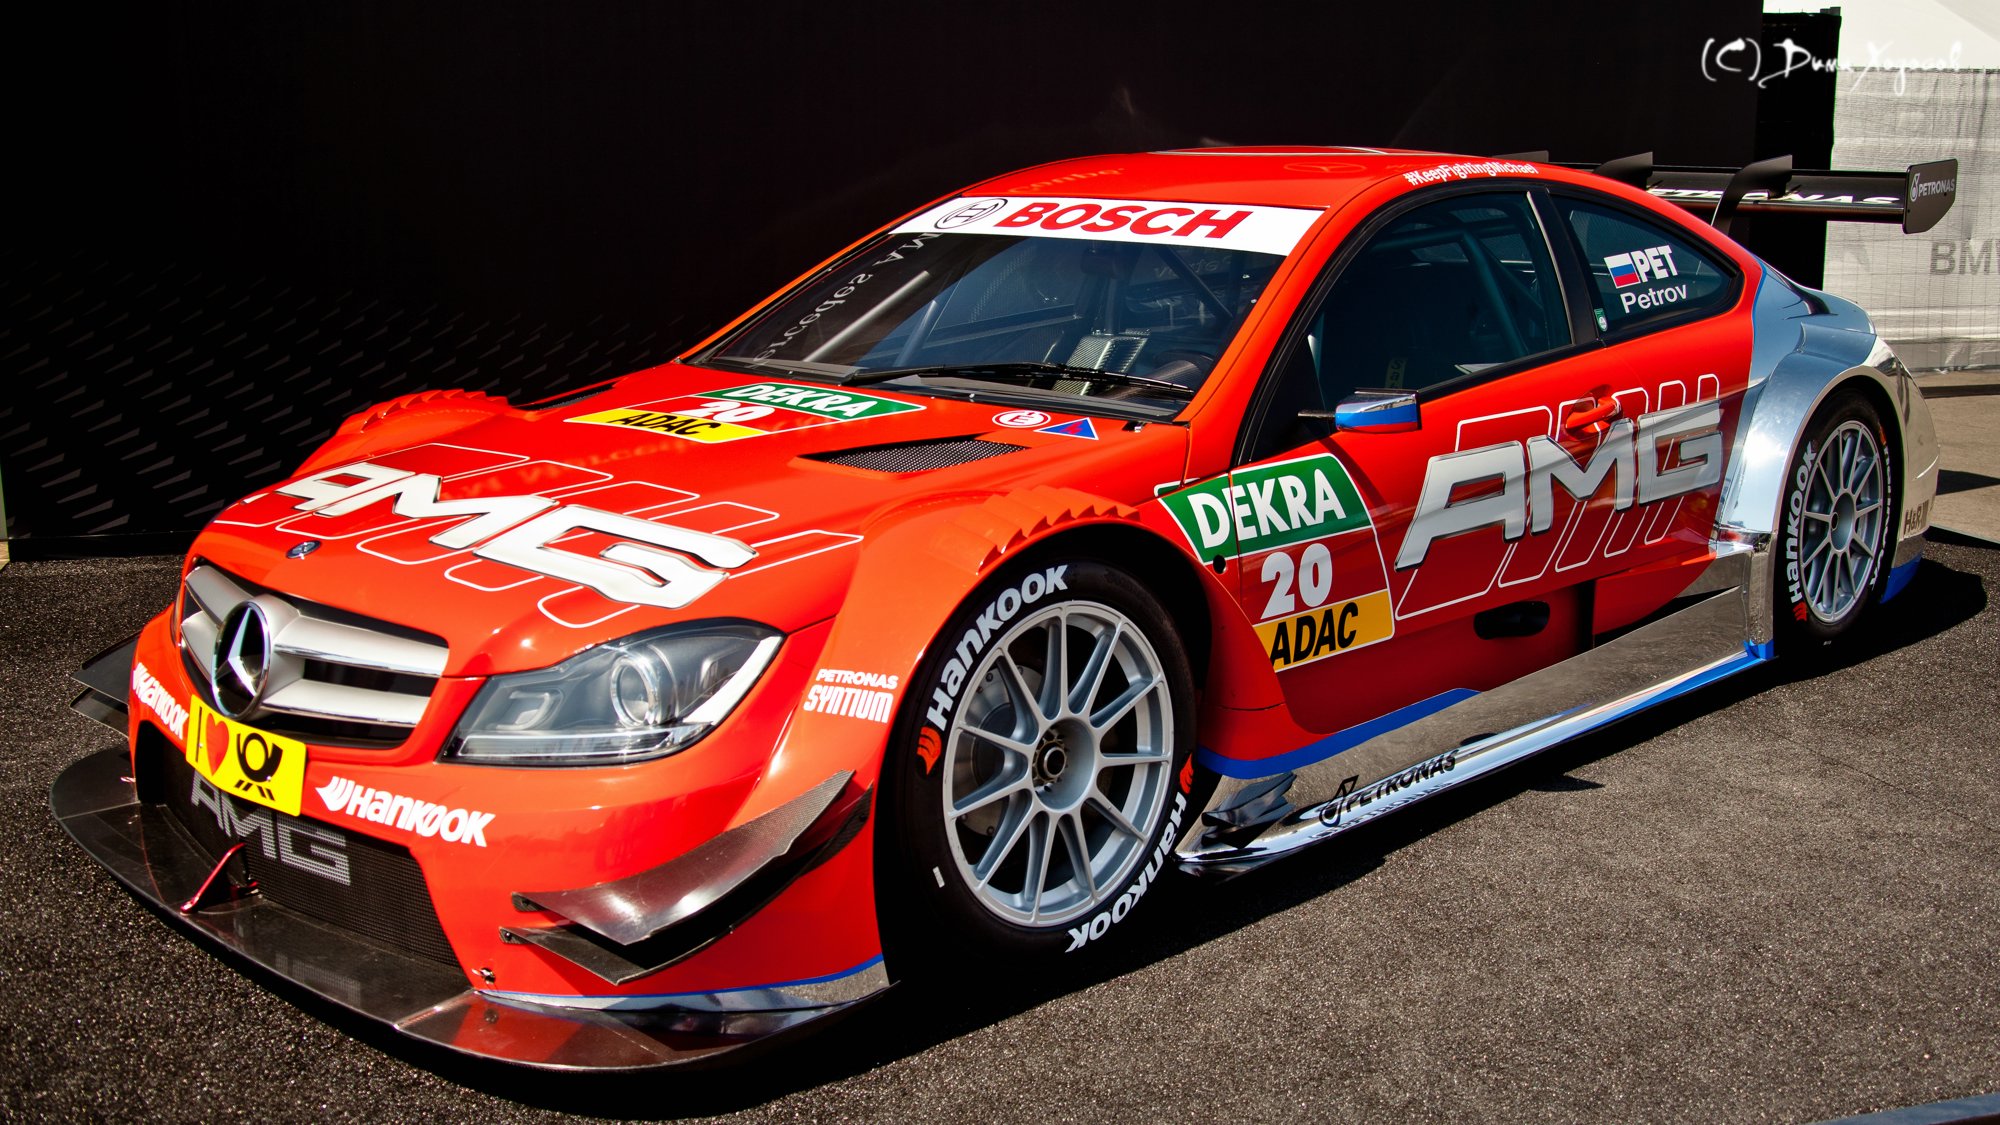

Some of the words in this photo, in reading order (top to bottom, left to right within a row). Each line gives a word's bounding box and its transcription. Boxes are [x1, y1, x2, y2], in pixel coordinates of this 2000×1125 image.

[1402, 161, 1540, 187] #KeepFightingMichael
[1917, 177, 1956, 199] PETRONAS
[993, 202, 1253, 240] BOSCH
[1630, 244, 1679, 283] PET
[1620, 284, 1688, 314] Petrov
[668, 400, 775, 423] 20
[721, 384, 879, 418] DEKRA
[607, 412, 722, 436] ADAC
[1395, 400, 1724, 572] AMG
[1186, 468, 1347, 550] DEKRA
[243, 460, 759, 609] AMG
[1260, 543, 1334, 619] 20
[1269, 602, 1359, 667] ADAC
[815, 669, 899, 690] PETRONAS
[803, 684, 894, 724] SYNTIUM
[1345, 749, 1460, 813] PETRONAS
[191, 769, 352, 887] AMG
